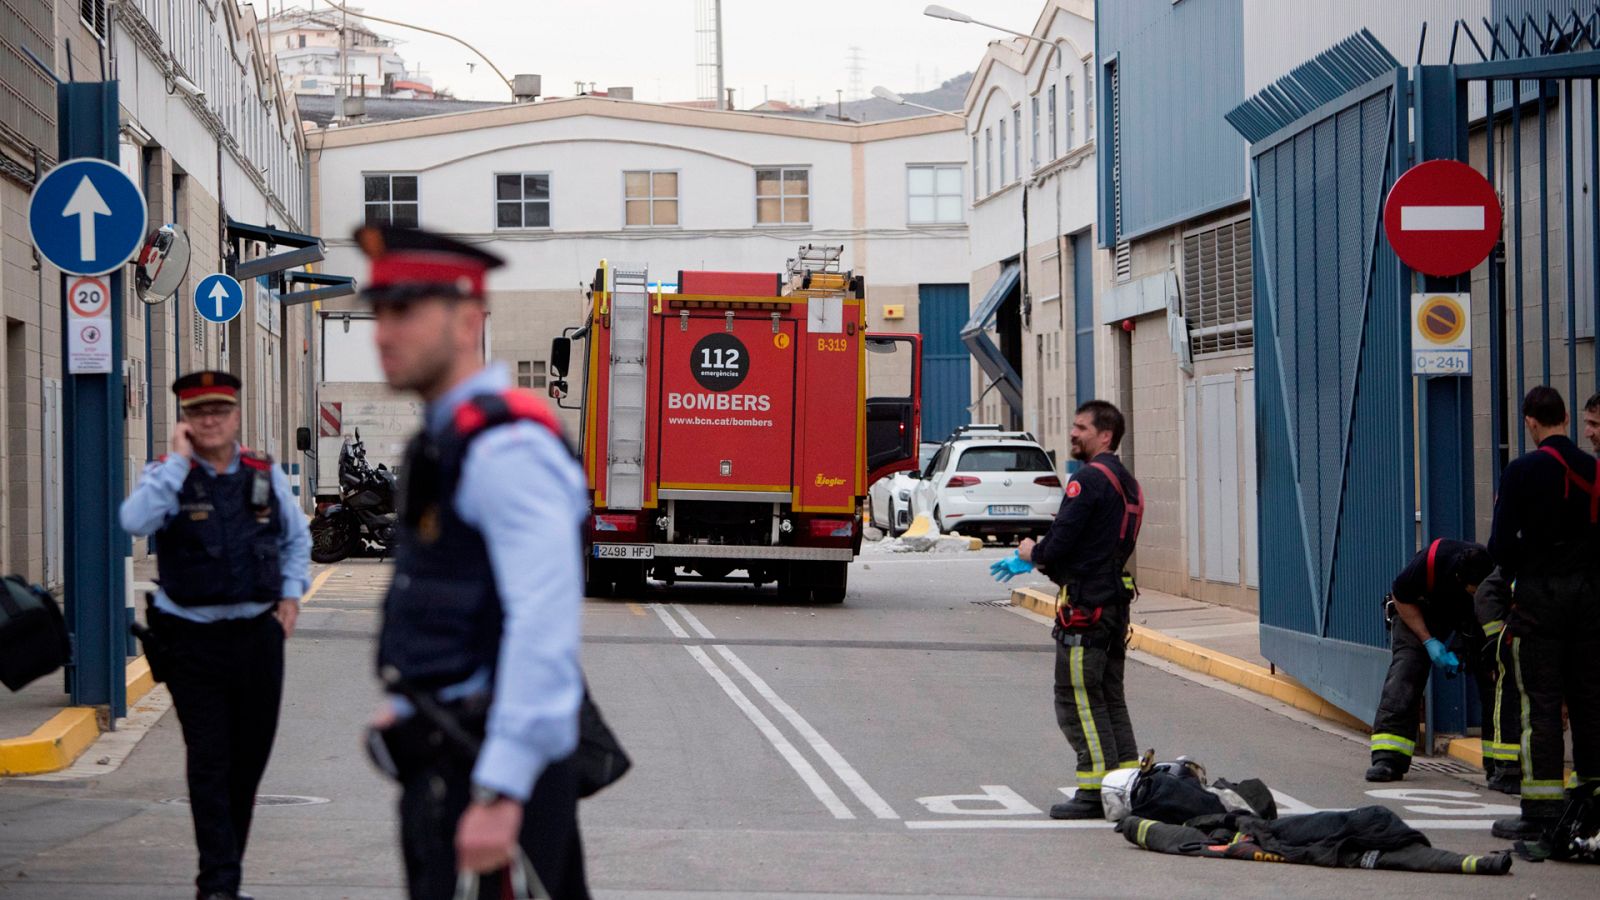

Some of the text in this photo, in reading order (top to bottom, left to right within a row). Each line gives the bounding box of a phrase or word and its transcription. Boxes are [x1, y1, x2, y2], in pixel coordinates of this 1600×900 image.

[78, 290, 101, 304] 20
[817, 338, 848, 352] B-319
[700, 348, 740, 369] 112
[700, 370, 739, 378] emergències
[668, 392, 772, 412] BOMBERS
[668, 416, 773, 428] www.bcn.cat/bombers
[601, 546, 652, 558] 2498 HFJ
